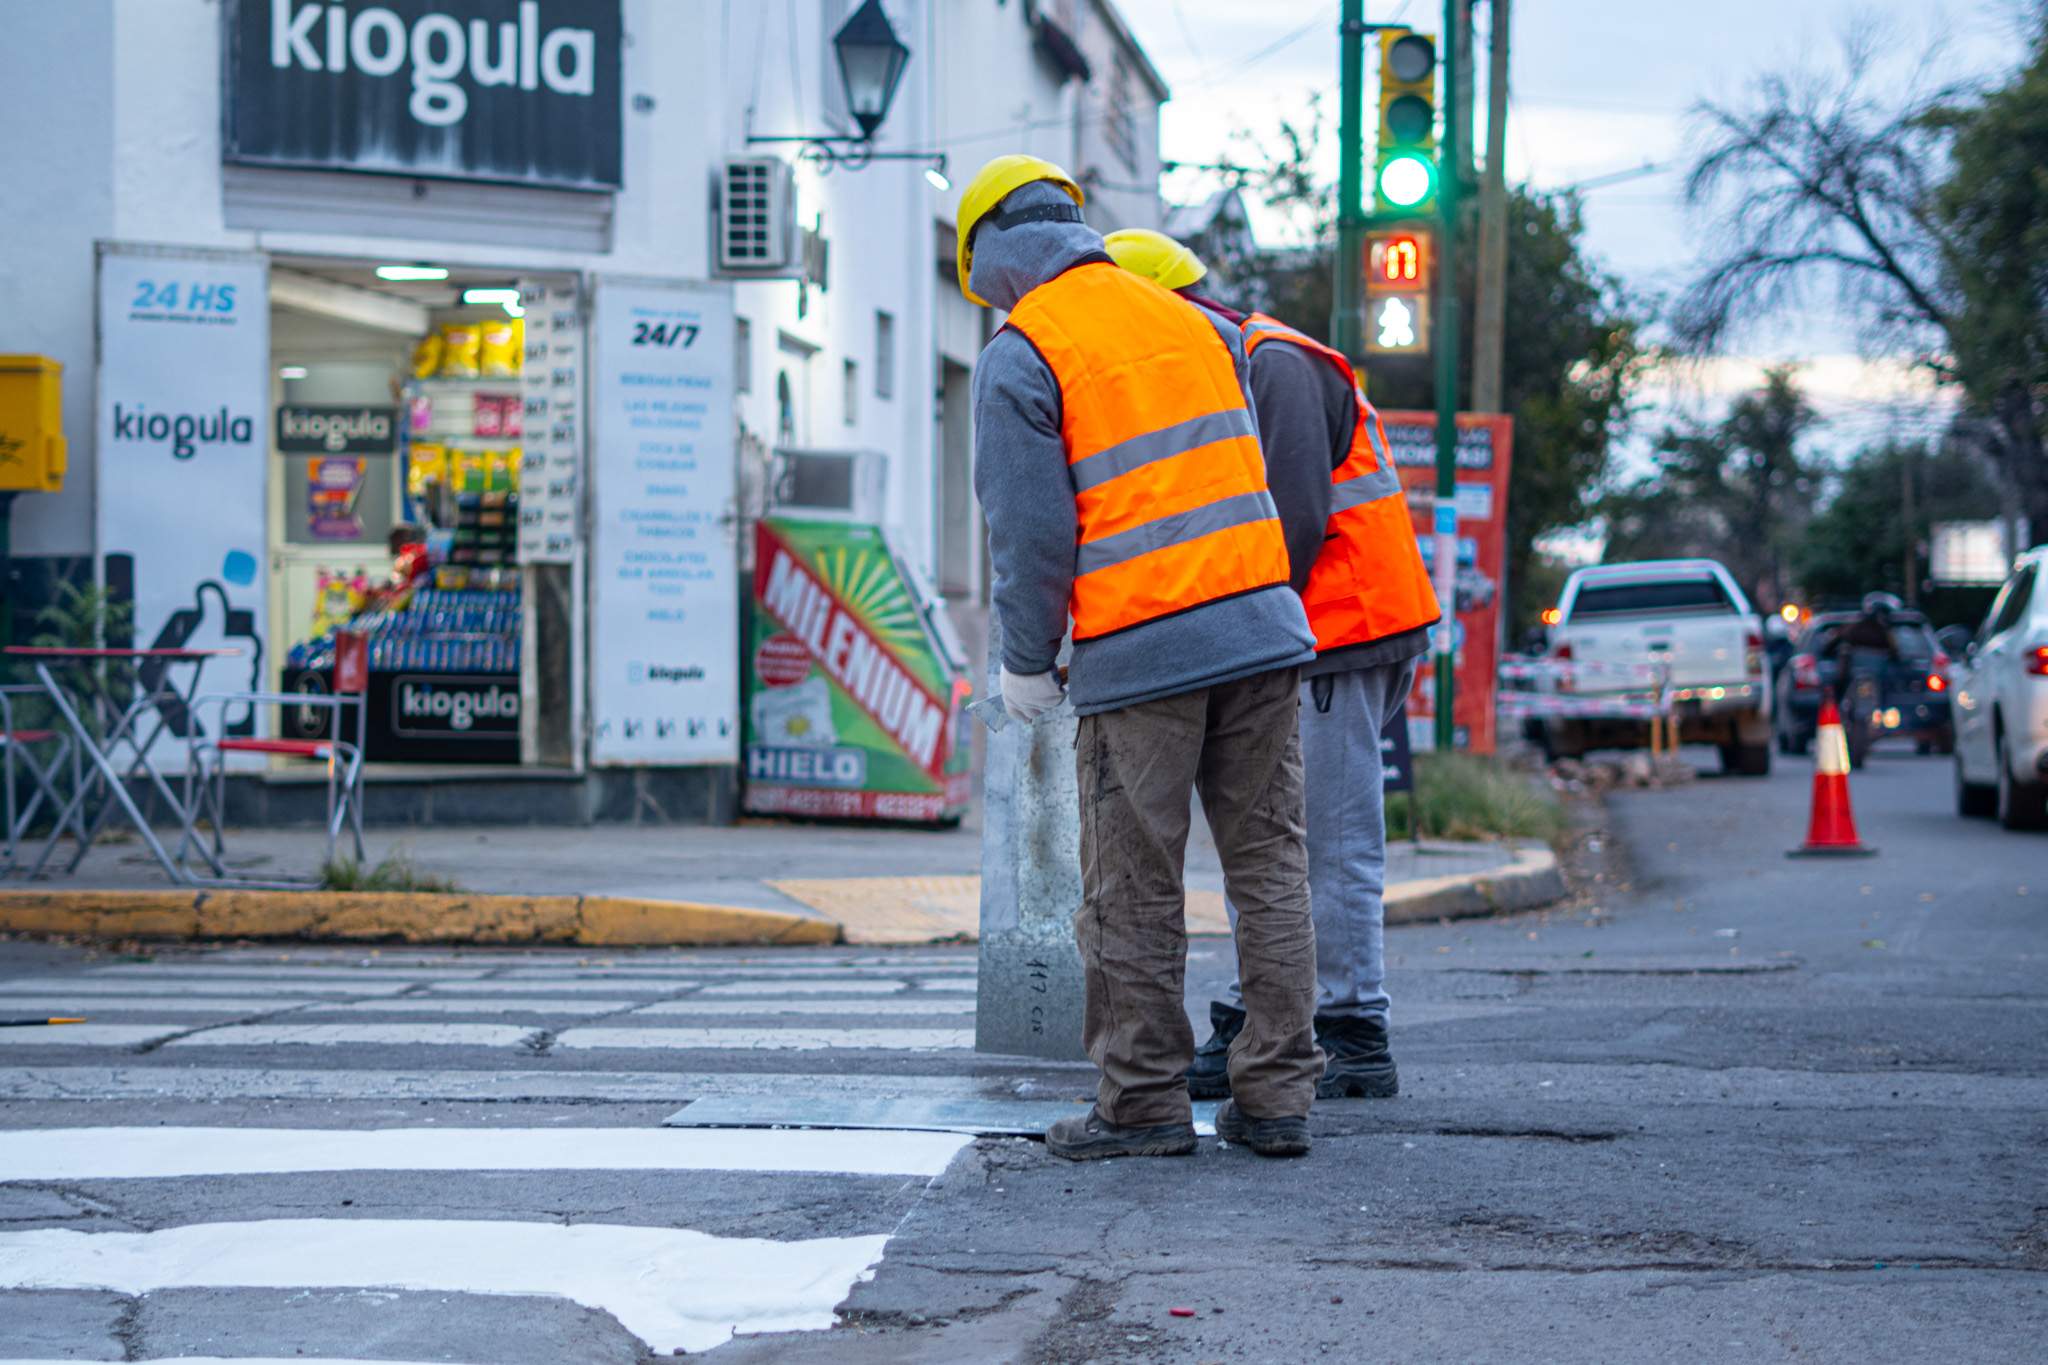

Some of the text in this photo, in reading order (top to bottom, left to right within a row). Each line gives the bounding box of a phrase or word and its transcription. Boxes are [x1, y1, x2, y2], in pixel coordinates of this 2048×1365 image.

[271, 0, 595, 126] kiogula
[132, 281, 236, 312] 24 HS
[632, 321, 700, 348] 24/7
[114, 402, 252, 460] kiogula
[283, 409, 389, 450] kiogula
[764, 549, 944, 768] MILENIUM
[403, 683, 518, 730] kiogula
[750, 750, 859, 781] HIELO
